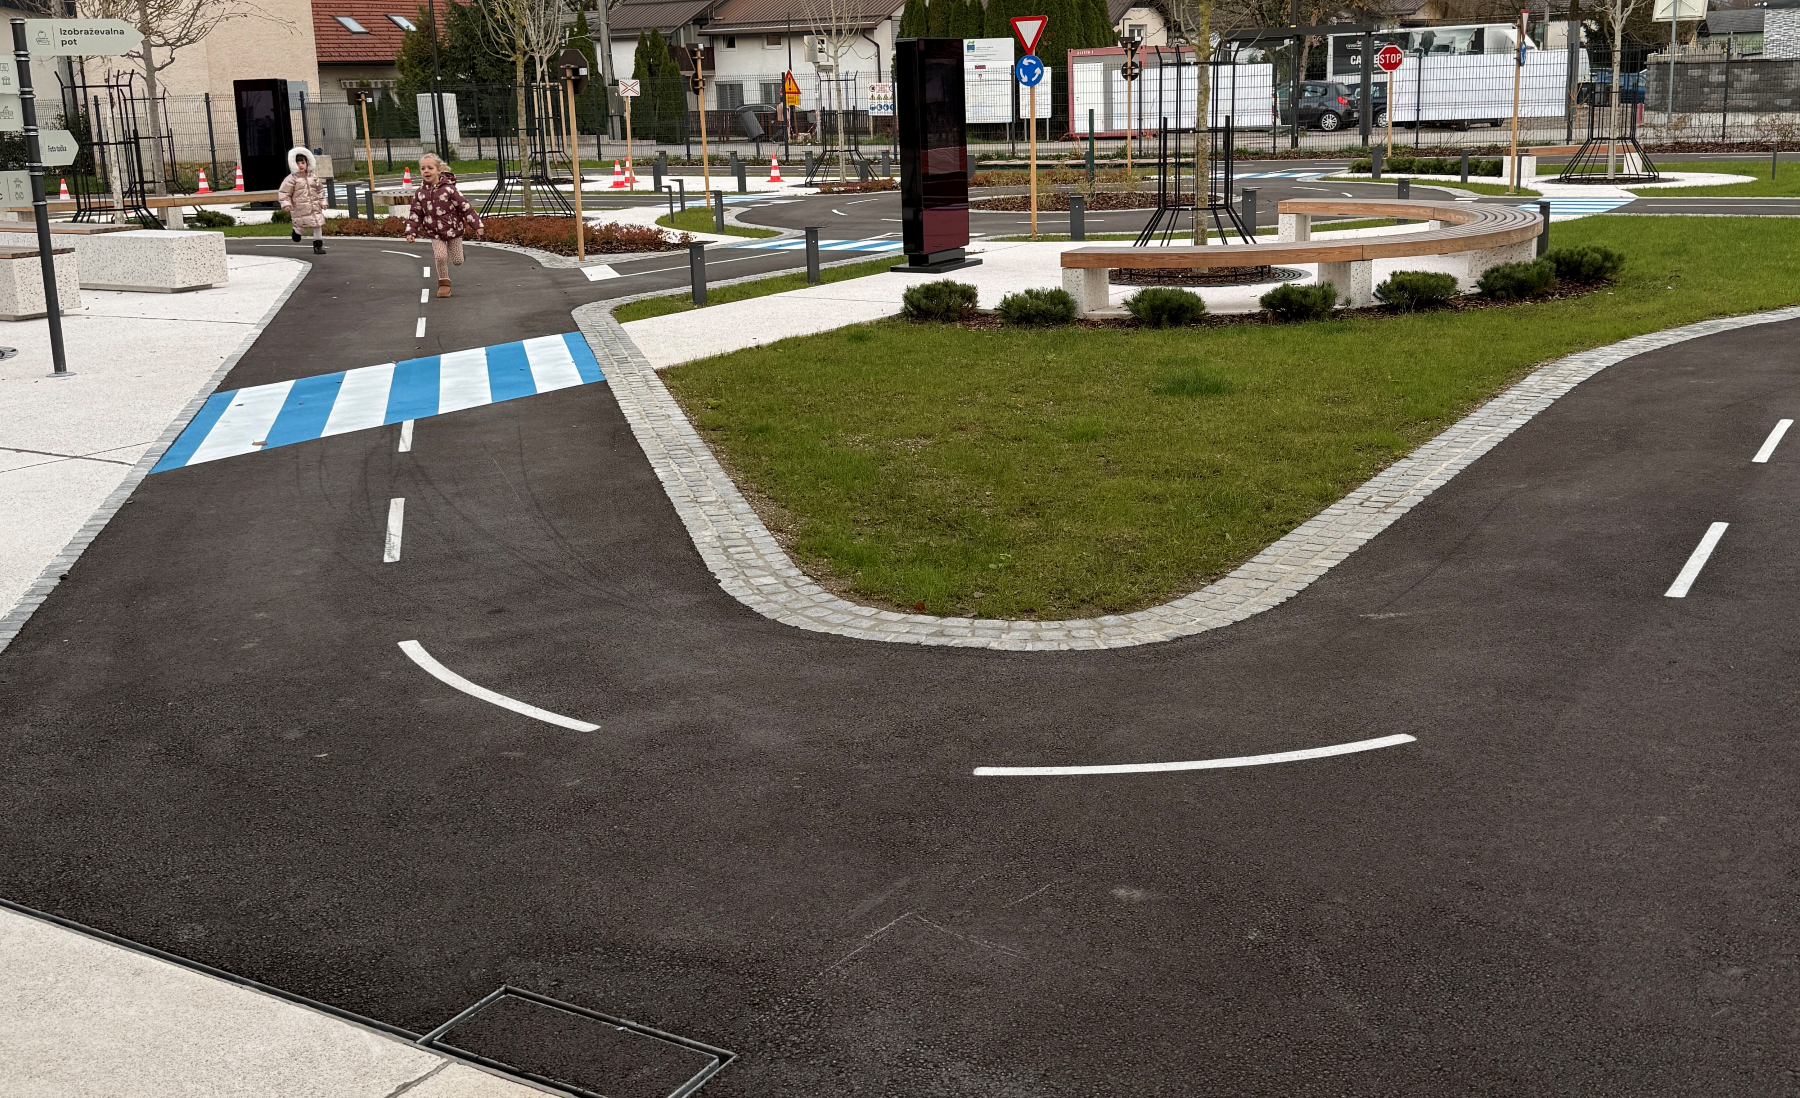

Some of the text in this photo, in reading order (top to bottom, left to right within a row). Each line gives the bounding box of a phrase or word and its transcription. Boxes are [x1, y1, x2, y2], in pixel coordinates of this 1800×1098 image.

[59, 28, 125, 36] Izobraževalna
[61, 38, 78, 47] pot
[1379, 53, 1402, 64] STOP
